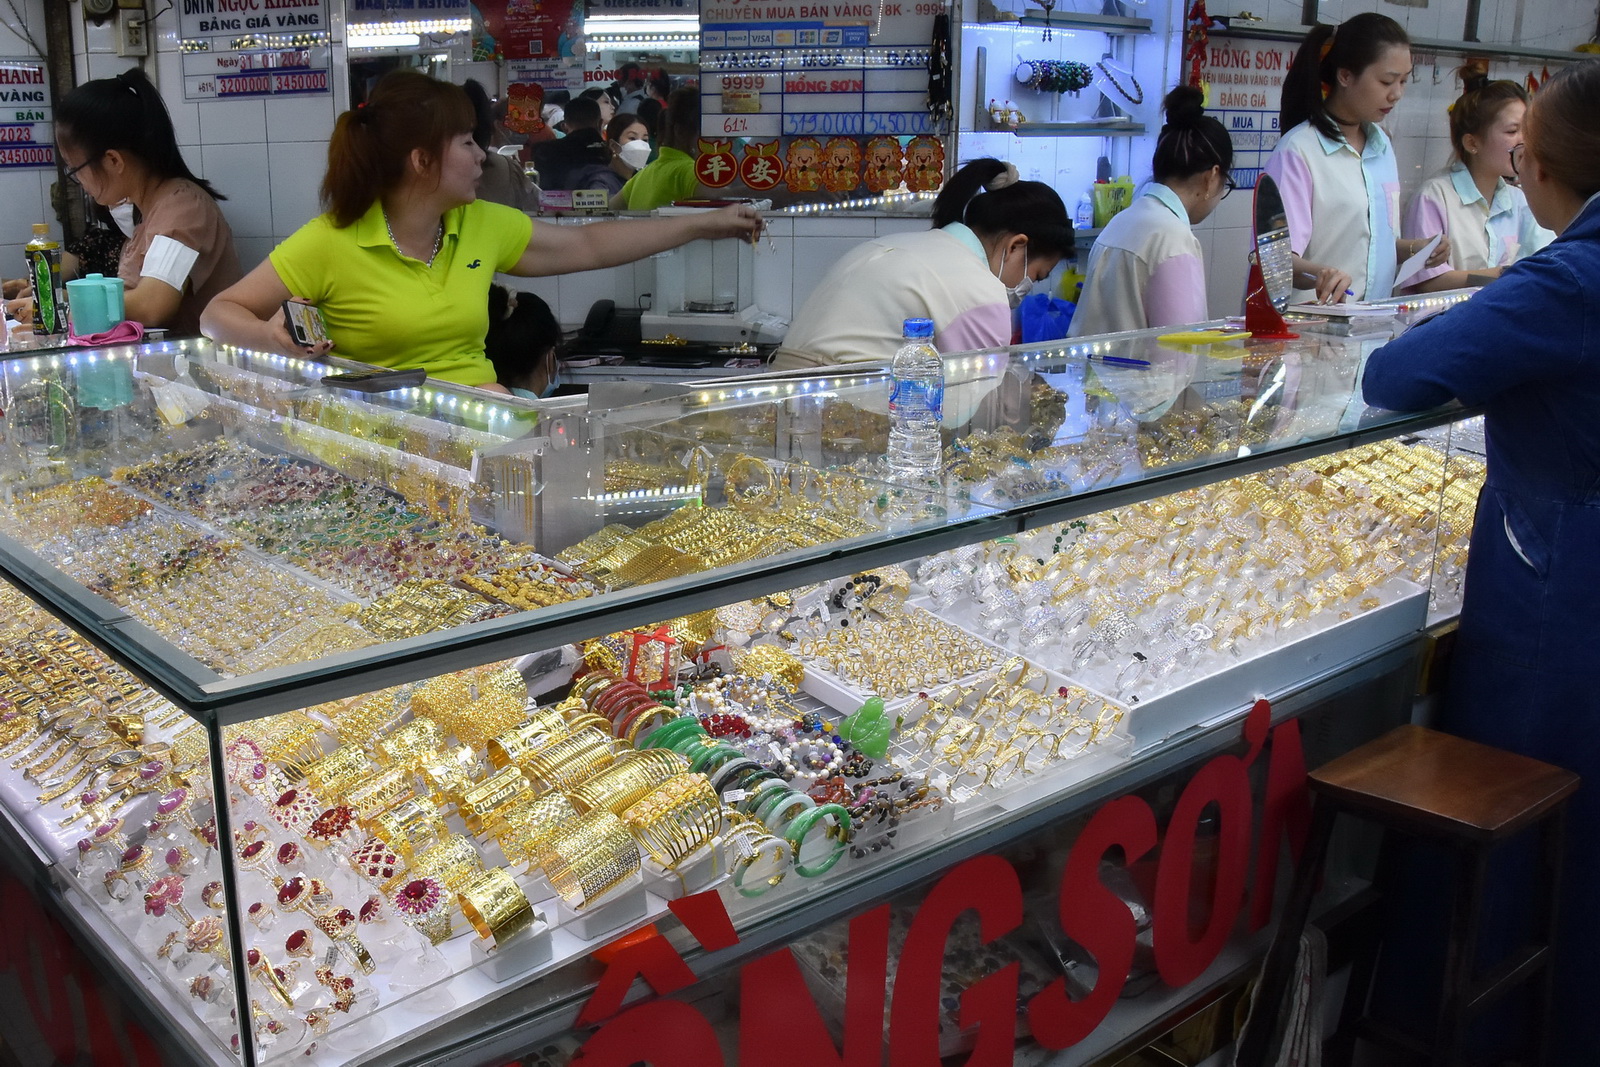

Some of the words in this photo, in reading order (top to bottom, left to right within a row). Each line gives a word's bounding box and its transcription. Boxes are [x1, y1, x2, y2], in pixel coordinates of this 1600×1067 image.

[705, 5, 762, 20] CHUYÊN
[766, 7, 796, 19] MUA
[800, 5, 829, 18] BÁN
[835, 3, 873, 17] VÀNG
[199, 16, 241, 31] BẢNG
[245, 14, 271, 28] GIÁ
[276, 12, 319, 27] VÀNG
[751, 35, 771, 43] VISA
[217, 57, 239, 68] Ngày
[281, 51, 310, 67] 2023
[801, 53, 845, 67] MUA
[1210, 41, 1251, 69] HỒNG
[1255, 49, 1282, 71] SƠN
[583, 64, 623, 82] HỒNG
[1218, 74, 1232, 84] MUA
[1234, 72, 1249, 85] BÁN
[1250, 73, 1269, 86] VÀNG
[220, 77, 269, 93] 3200000
[276, 74, 326, 90] 3450000
[721, 76, 765, 90] 9999
[785, 75, 827, 92] HỒNG
[830, 79, 863, 91] SƠN
[0, 89, 44, 102] VÀNG
[1220, 88, 1247, 107] BẢNG
[1250, 91, 1267, 107] GIÁ
[16, 110, 44, 121] BÁN
[1232, 116, 1254, 129] MUA
[723, 117, 748, 133] 61%
[0, 127, 31, 141] 2023
[0, 148, 53, 164] 3450000
